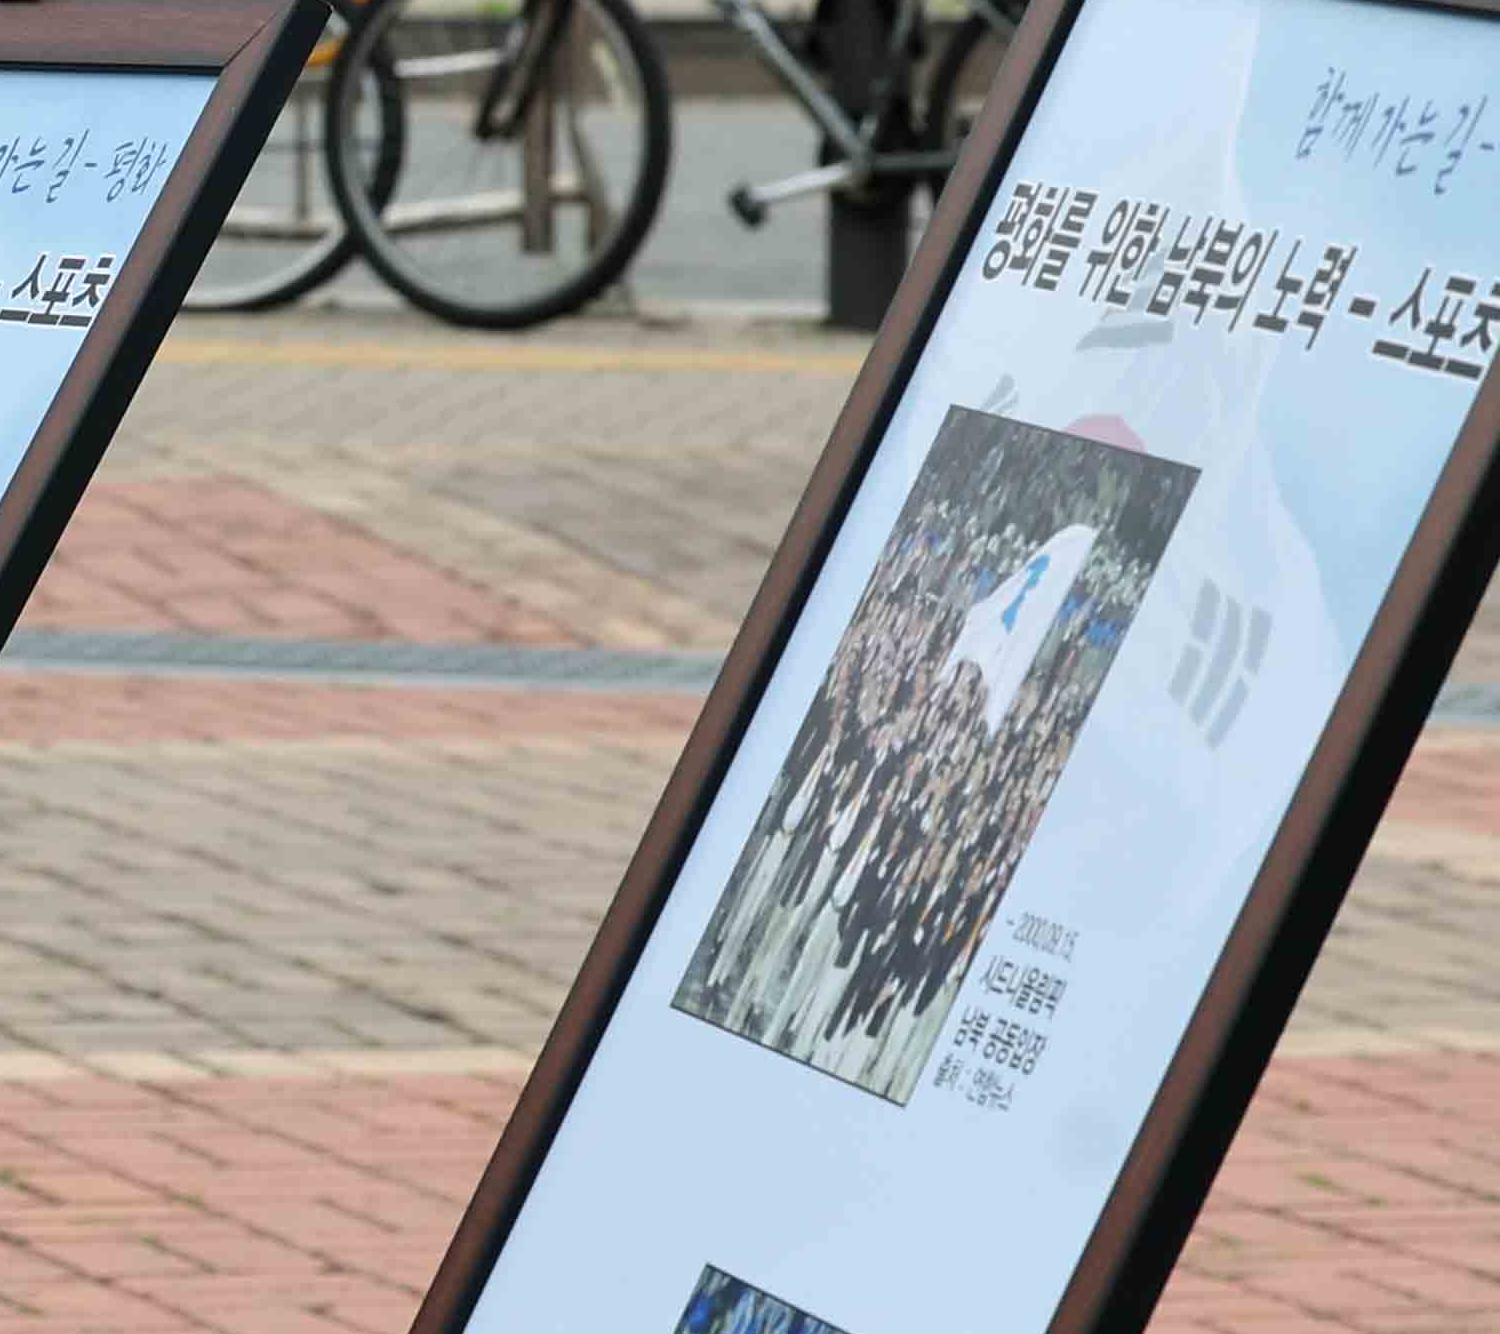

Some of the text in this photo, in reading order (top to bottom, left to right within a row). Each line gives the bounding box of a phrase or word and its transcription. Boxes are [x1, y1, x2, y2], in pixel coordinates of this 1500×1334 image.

[46, 129, 90, 203] 길
[104, 137, 168, 203] 평화
[1295, 67, 1380, 160] 함께
[1372, 96, 1440, 177] 가는
[1434, 95, 1488, 196] 길
[983, 183, 1098, 291] 평화를
[1079, 200, 1170, 309] 위한
[1142, 216, 1278, 332] 남북의
[1252, 240, 1358, 351] 노력
[979, 955, 1067, 1019] 시드니올림픽
[953, 1007, 1047, 1075] 남북 공동입장
